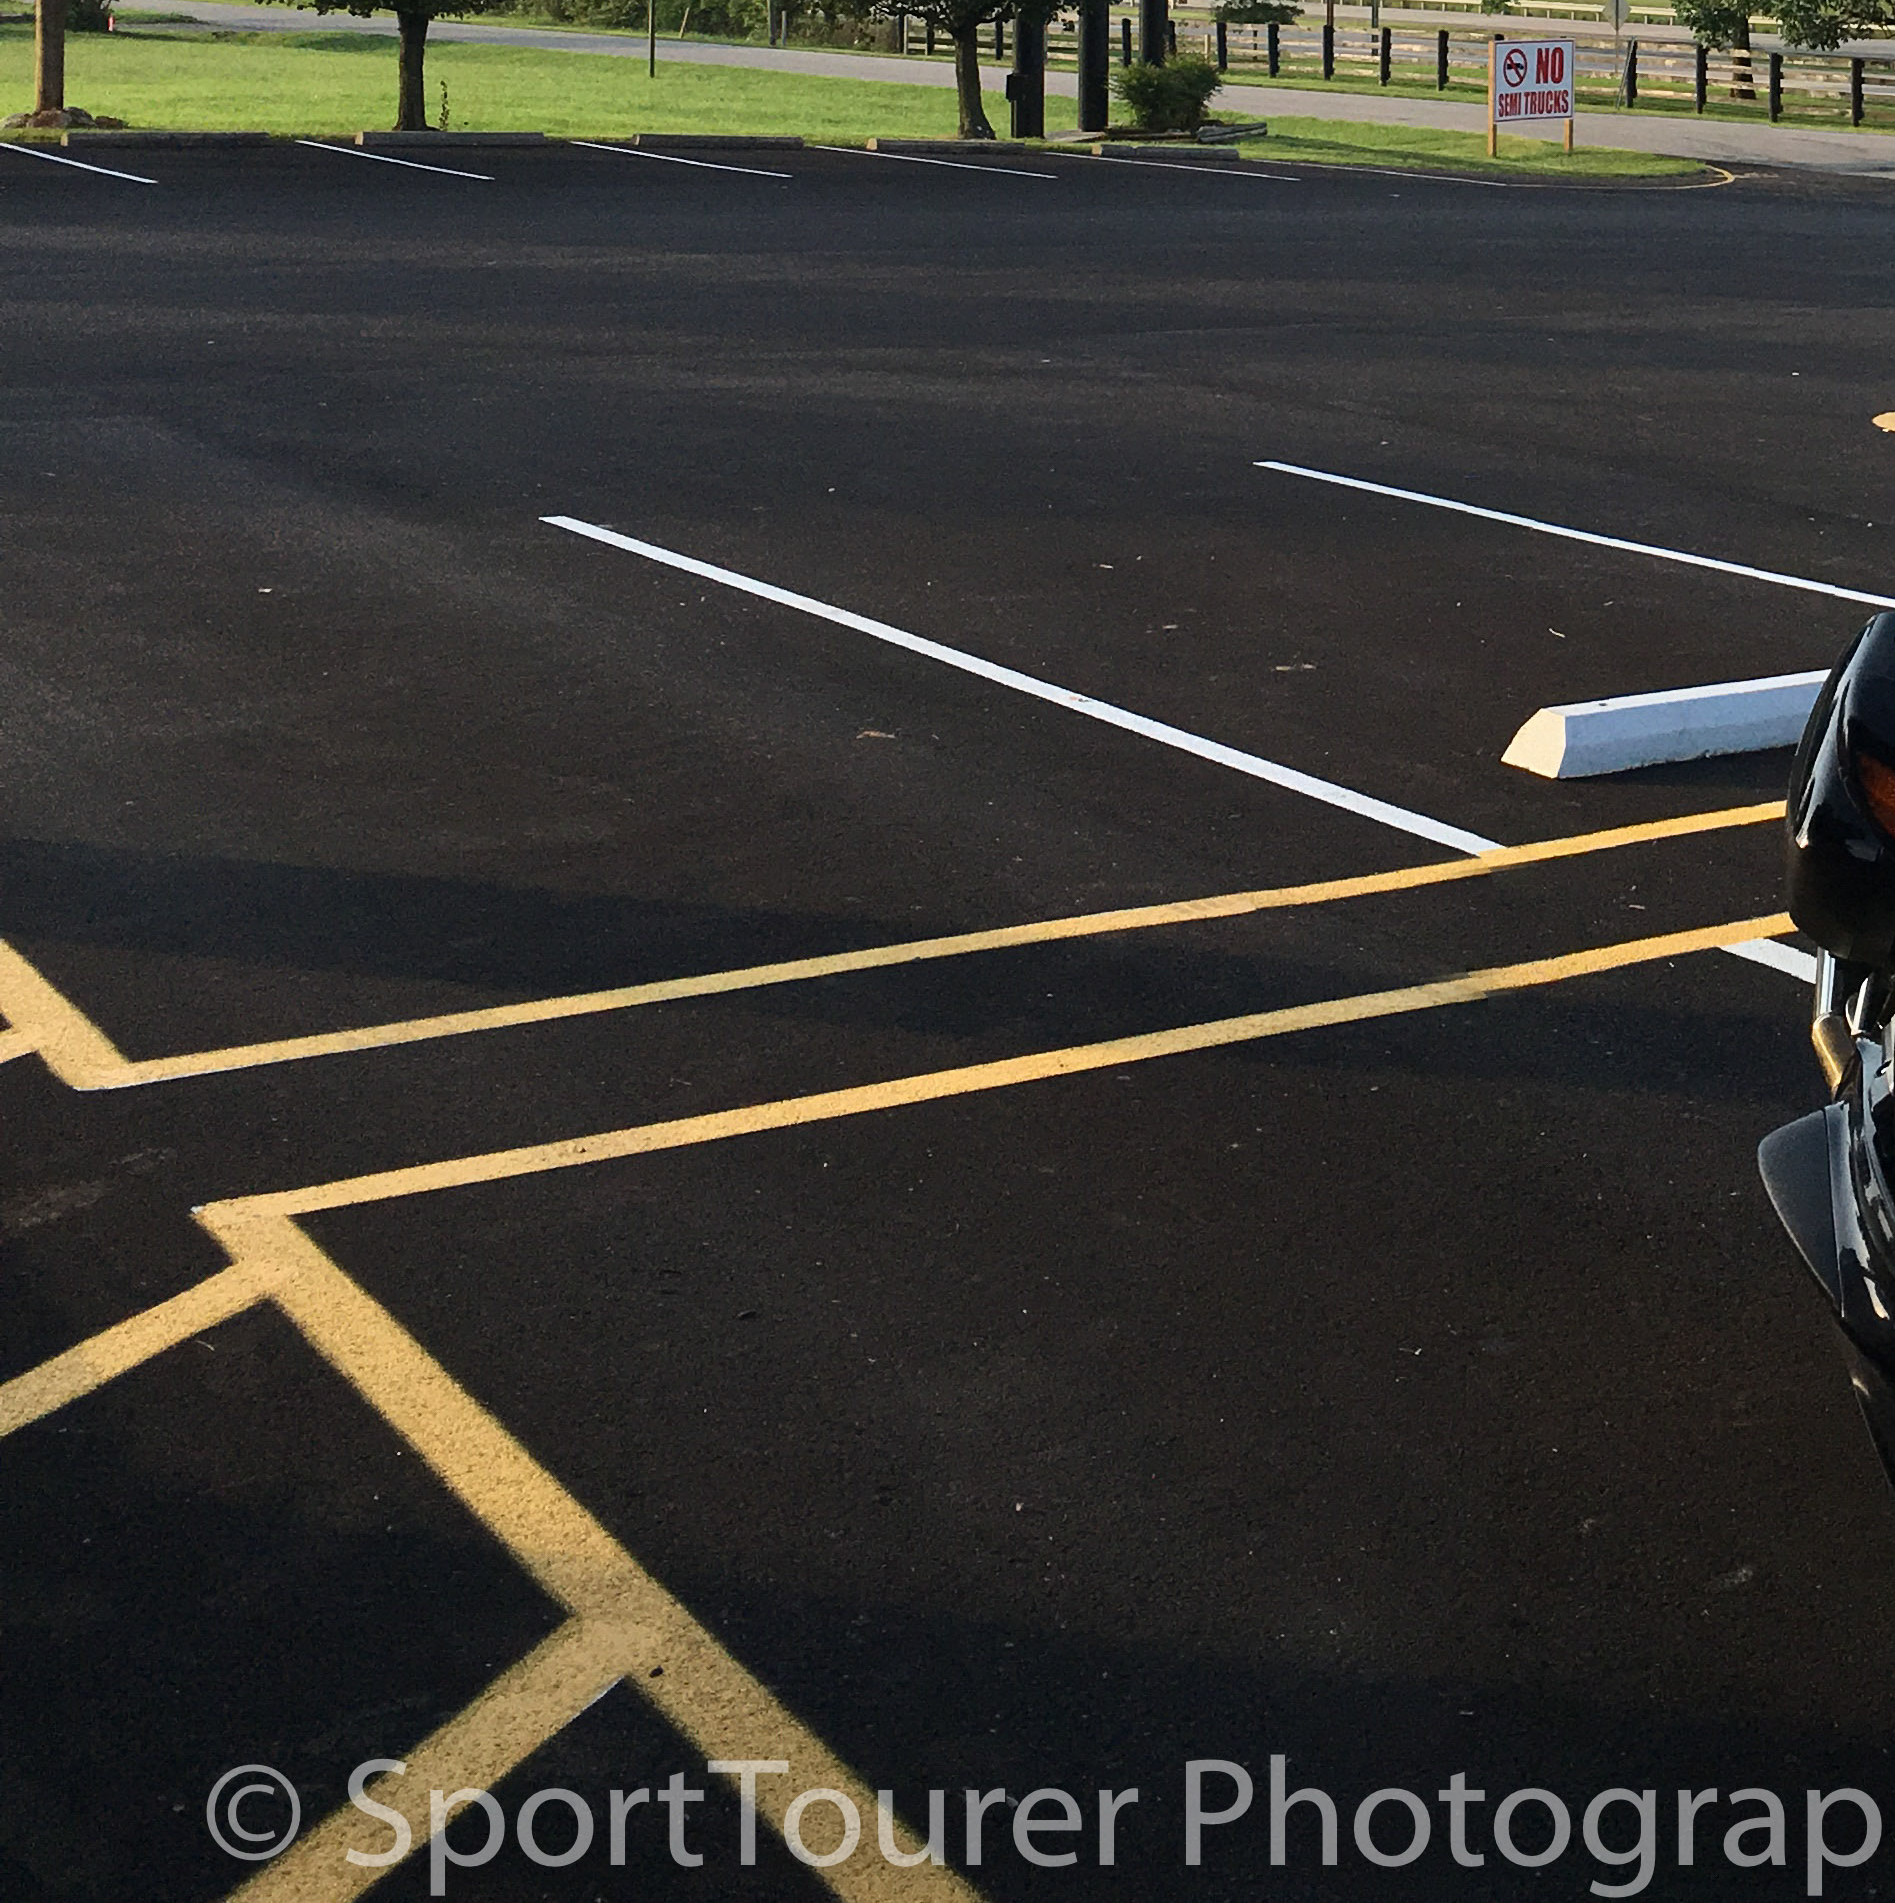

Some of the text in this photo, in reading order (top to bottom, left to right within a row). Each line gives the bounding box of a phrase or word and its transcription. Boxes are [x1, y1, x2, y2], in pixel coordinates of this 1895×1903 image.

[1536, 47, 1564, 84] NO
[1498, 90, 1569, 117] SEMI TRUCKS
